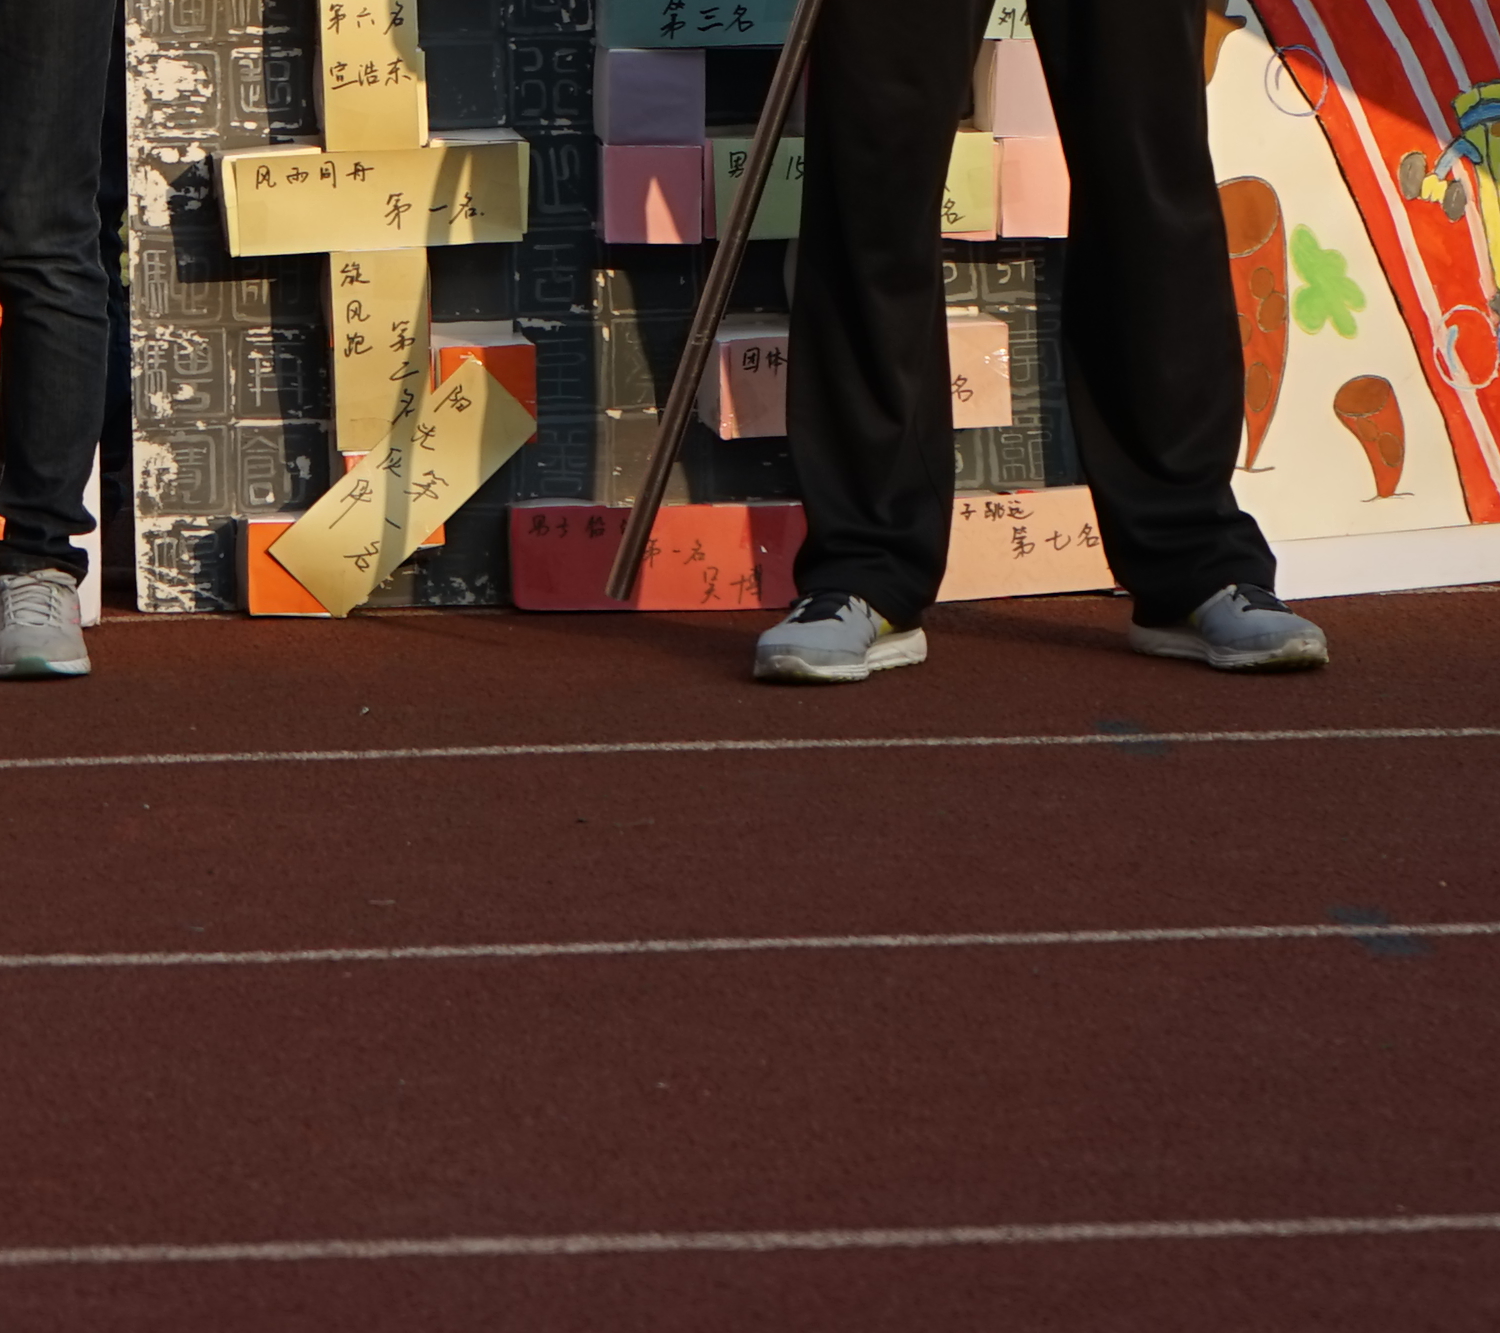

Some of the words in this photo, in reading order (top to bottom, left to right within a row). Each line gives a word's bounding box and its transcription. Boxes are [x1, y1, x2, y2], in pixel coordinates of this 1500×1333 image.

[326, 0, 405, 36] 第六名
[339, 261, 373, 359] 旋风跑
[742, 347, 788, 376] 团体
[528, 514, 628, 538] 男子铅
[1010, 522, 1100, 560] 第七名
